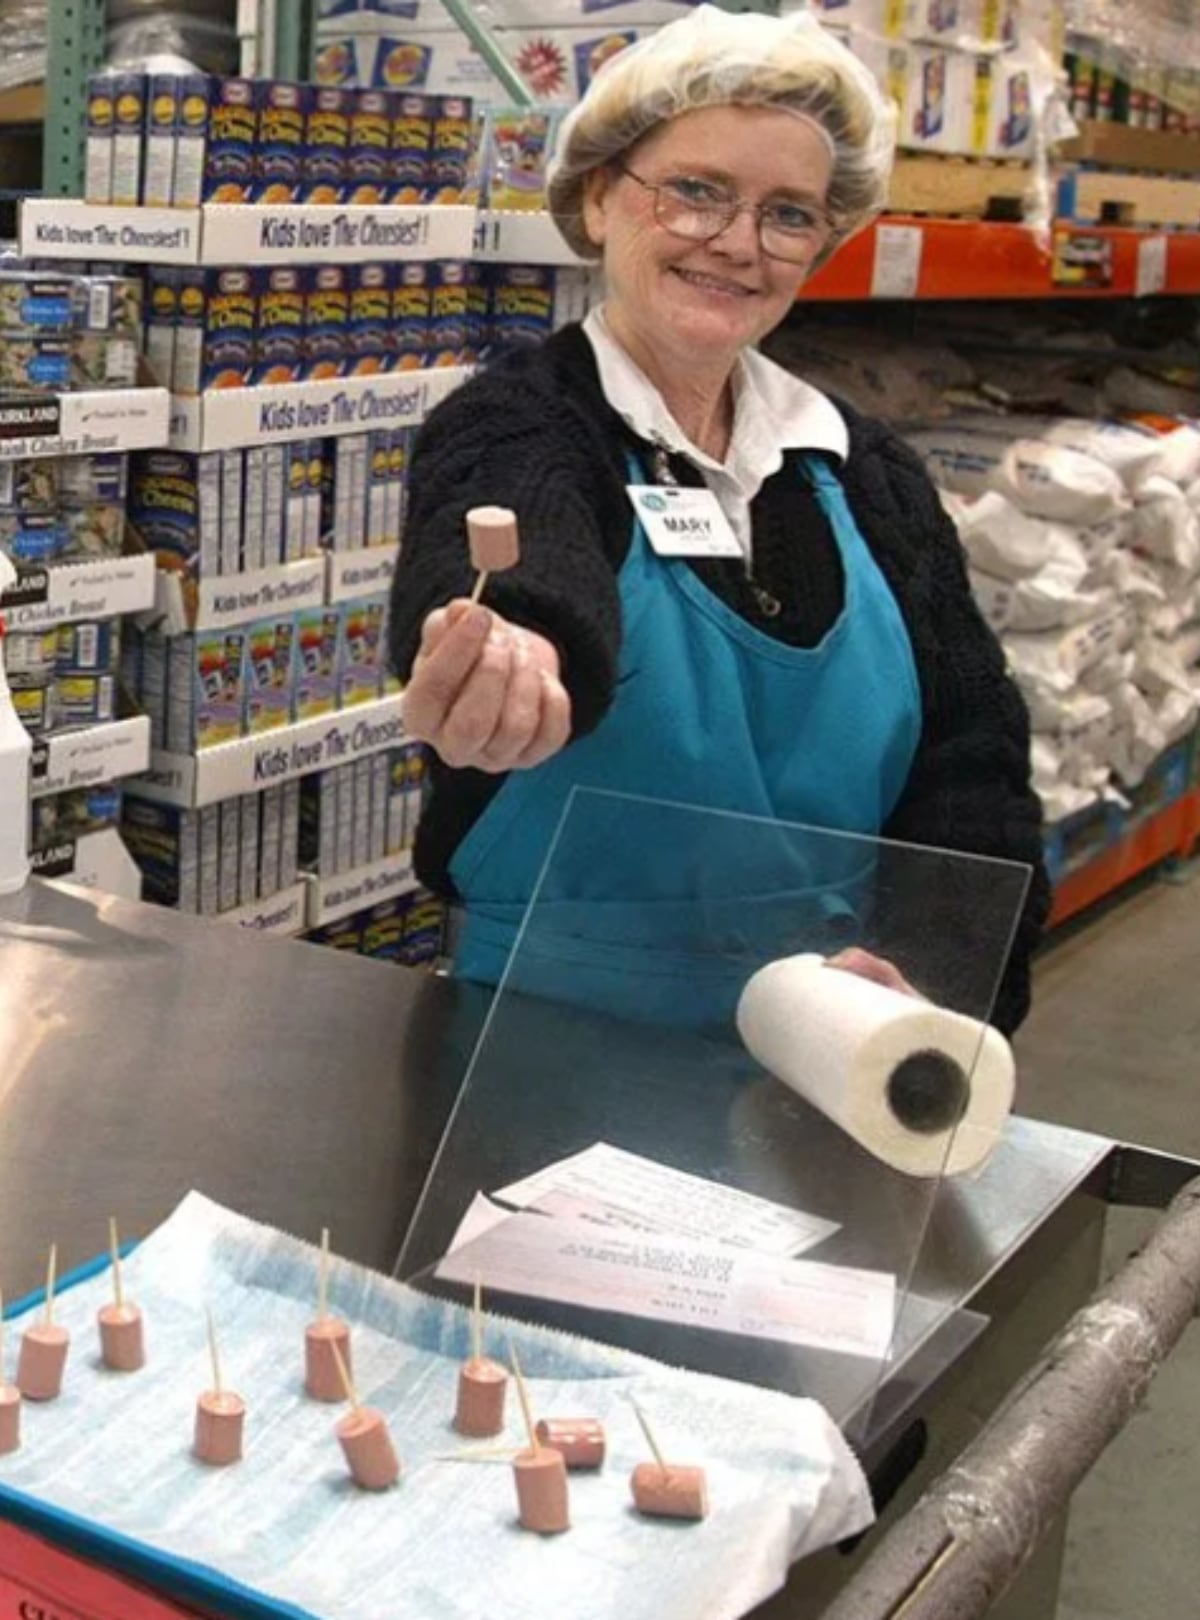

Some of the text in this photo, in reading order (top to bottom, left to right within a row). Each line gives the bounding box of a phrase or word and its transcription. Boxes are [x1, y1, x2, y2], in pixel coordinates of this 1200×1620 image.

[36, 223, 63, 243] Kids
[66, 225, 93, 244] love
[95, 224, 118, 245] The
[260, 218, 296, 248] Kids
[299, 218, 331, 248] love
[333, 216, 358, 245] The
[260, 403, 294, 432] Kids
[299, 402, 328, 426] love
[333, 393, 354, 423] The
[663, 516, 711, 535] MARY
[253, 746, 288, 781] Kids
[290, 739, 323, 769] love
[325, 727, 350, 757] The
